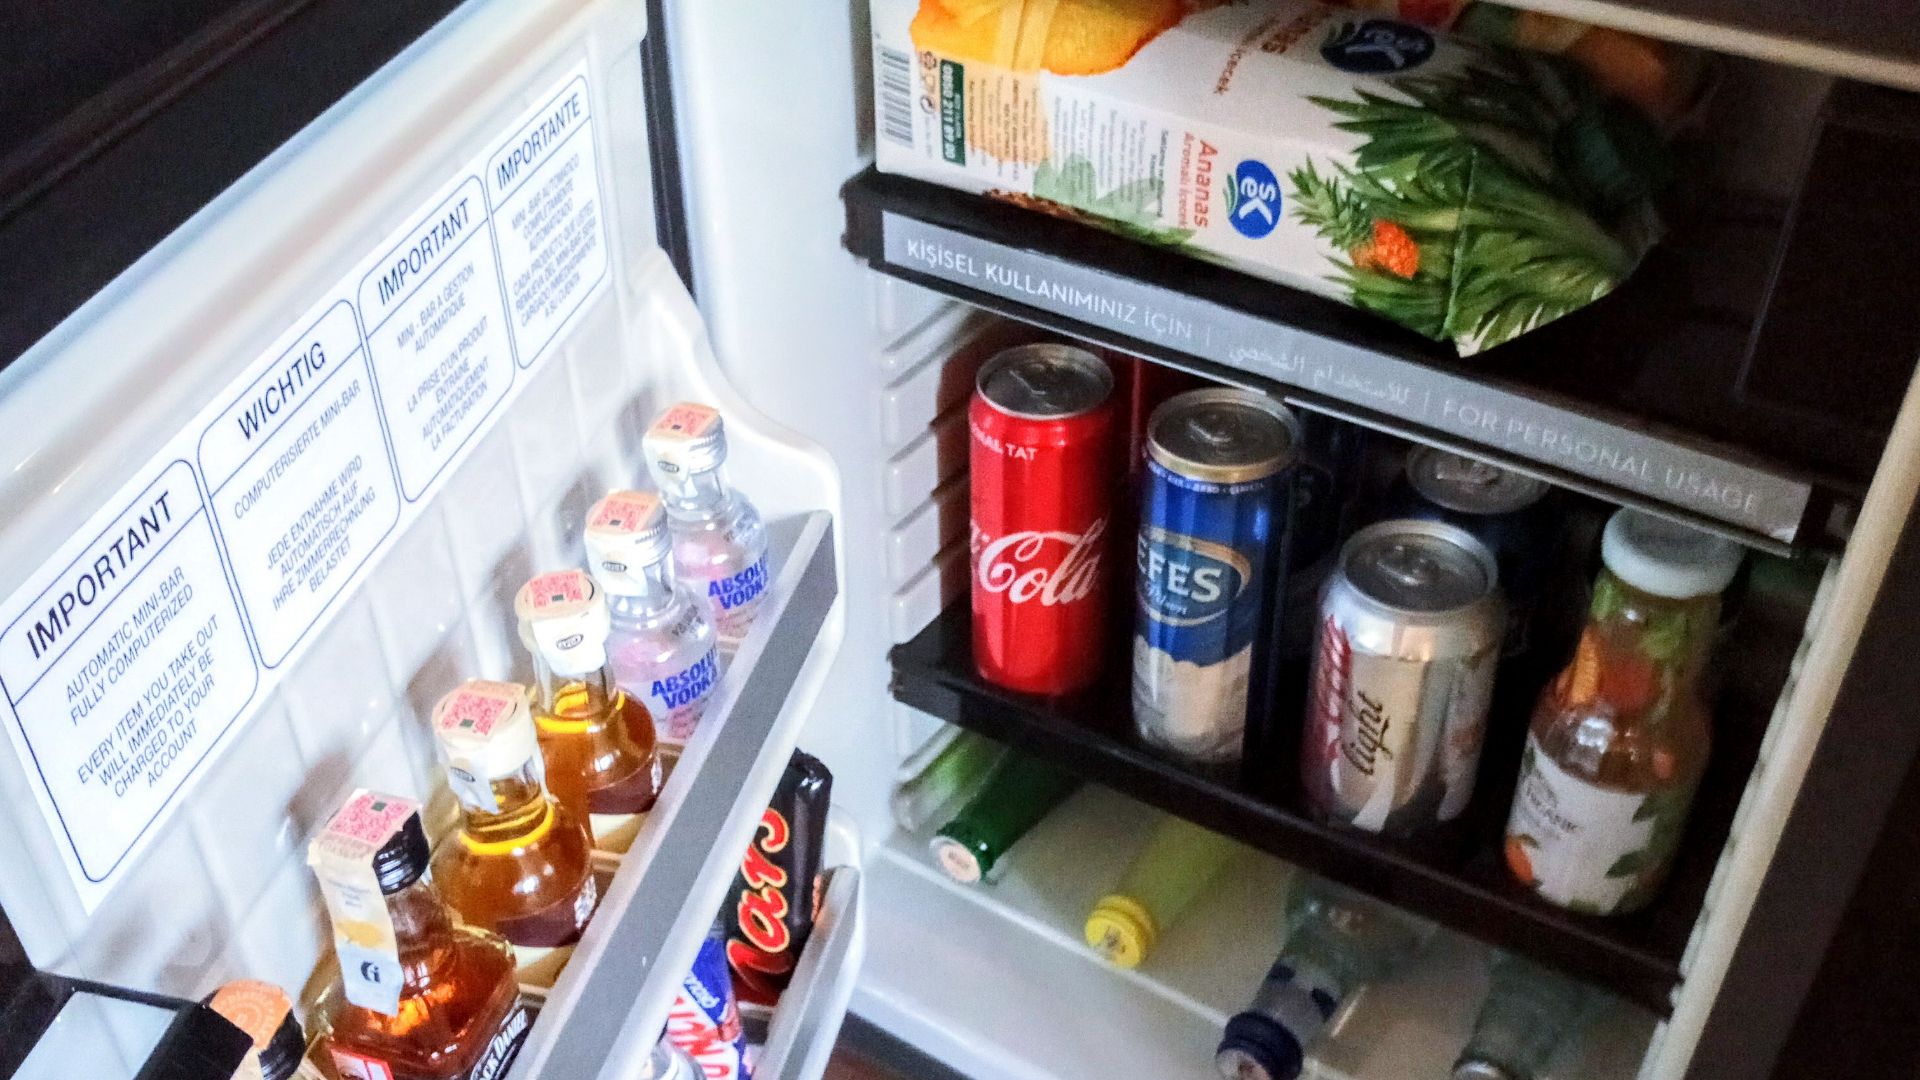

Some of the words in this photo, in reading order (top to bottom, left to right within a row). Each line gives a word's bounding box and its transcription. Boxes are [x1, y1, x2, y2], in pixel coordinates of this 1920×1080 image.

[496, 92, 580, 191] IMPORTANTE
[1194, 139, 1219, 228] Ananas
[377, 197, 470, 305] IMPORTANT
[907, 239, 979, 278] KİŞİSEL
[985, 262, 1136, 325] KULLANIMINIZ
[237, 342, 326, 441] WICHTIG
[234, 419, 321, 520] COMPUTERISIERTE
[319, 379, 361, 429] MINI-BAR
[1005, 443, 1038, 461] TAT
[1443, 399, 1498, 433] FOR
[1507, 418, 1648, 479] PERSONAL
[1665, 467, 1758, 514] USAGE
[267, 533, 292, 570] JEDE
[290, 480, 339, 543] ENTNAHME
[338, 454, 363, 488] WIRD
[272, 577, 296, 611] IHRE
[295, 486, 376, 586] ZIMMERRECHNUNG
[280, 500, 342, 578] AUTOMATISCH
[342, 479, 359, 509] AUF
[308, 535, 351, 593] BELASTET
[979, 517, 1102, 607] Cola
[26, 490, 173, 660] IMPORTANT
[66, 621, 133, 704] AUTOMATIC
[131, 566, 185, 629] MINI-BAR
[70, 677, 106, 726] FULLY
[107, 583, 193, 685] COMPUTERIZED
[77, 733, 115, 785] EVERY
[115, 700, 144, 741] ITEM
[142, 671, 169, 707] YOU
[168, 640, 197, 679] TAKE
[196, 613, 218, 648] OUT
[98, 751, 130, 787] WILL
[127, 666, 197, 755] IMMEDIATELY
[197, 647, 214, 673] BE
[114, 728, 168, 798] CHARGED
[166, 709, 184, 734] TO
[183, 673, 215, 714] YOUR
[147, 717, 197, 788] ACCOUNT
[1341, 690, 1393, 775] light
